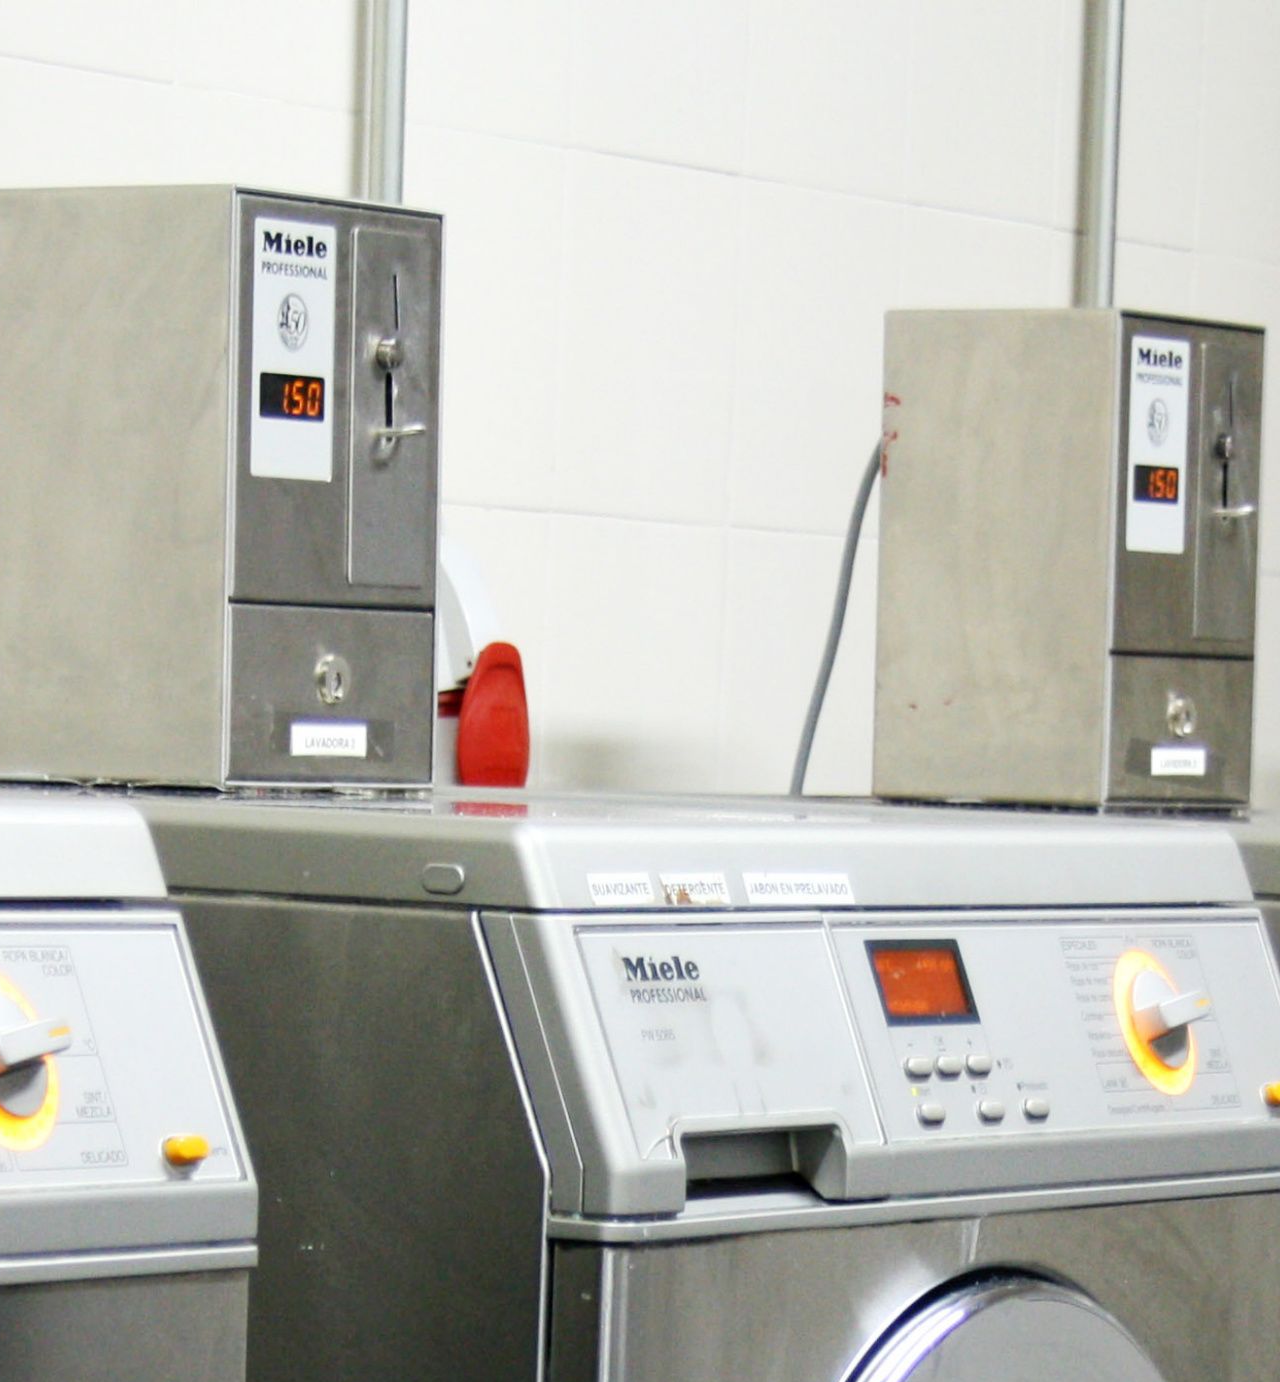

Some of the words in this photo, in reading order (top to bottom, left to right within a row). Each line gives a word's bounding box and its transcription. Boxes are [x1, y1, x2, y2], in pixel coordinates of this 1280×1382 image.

[262, 231, 328, 258] Miele
[261, 260, 328, 281] PROFESSIONAL
[1137, 347, 1183, 369] Miele
[592, 882, 651, 896] SUAVIZANTE
[621, 955, 701, 982] Miele
[630, 986, 708, 1003] PROFESSIONAL
